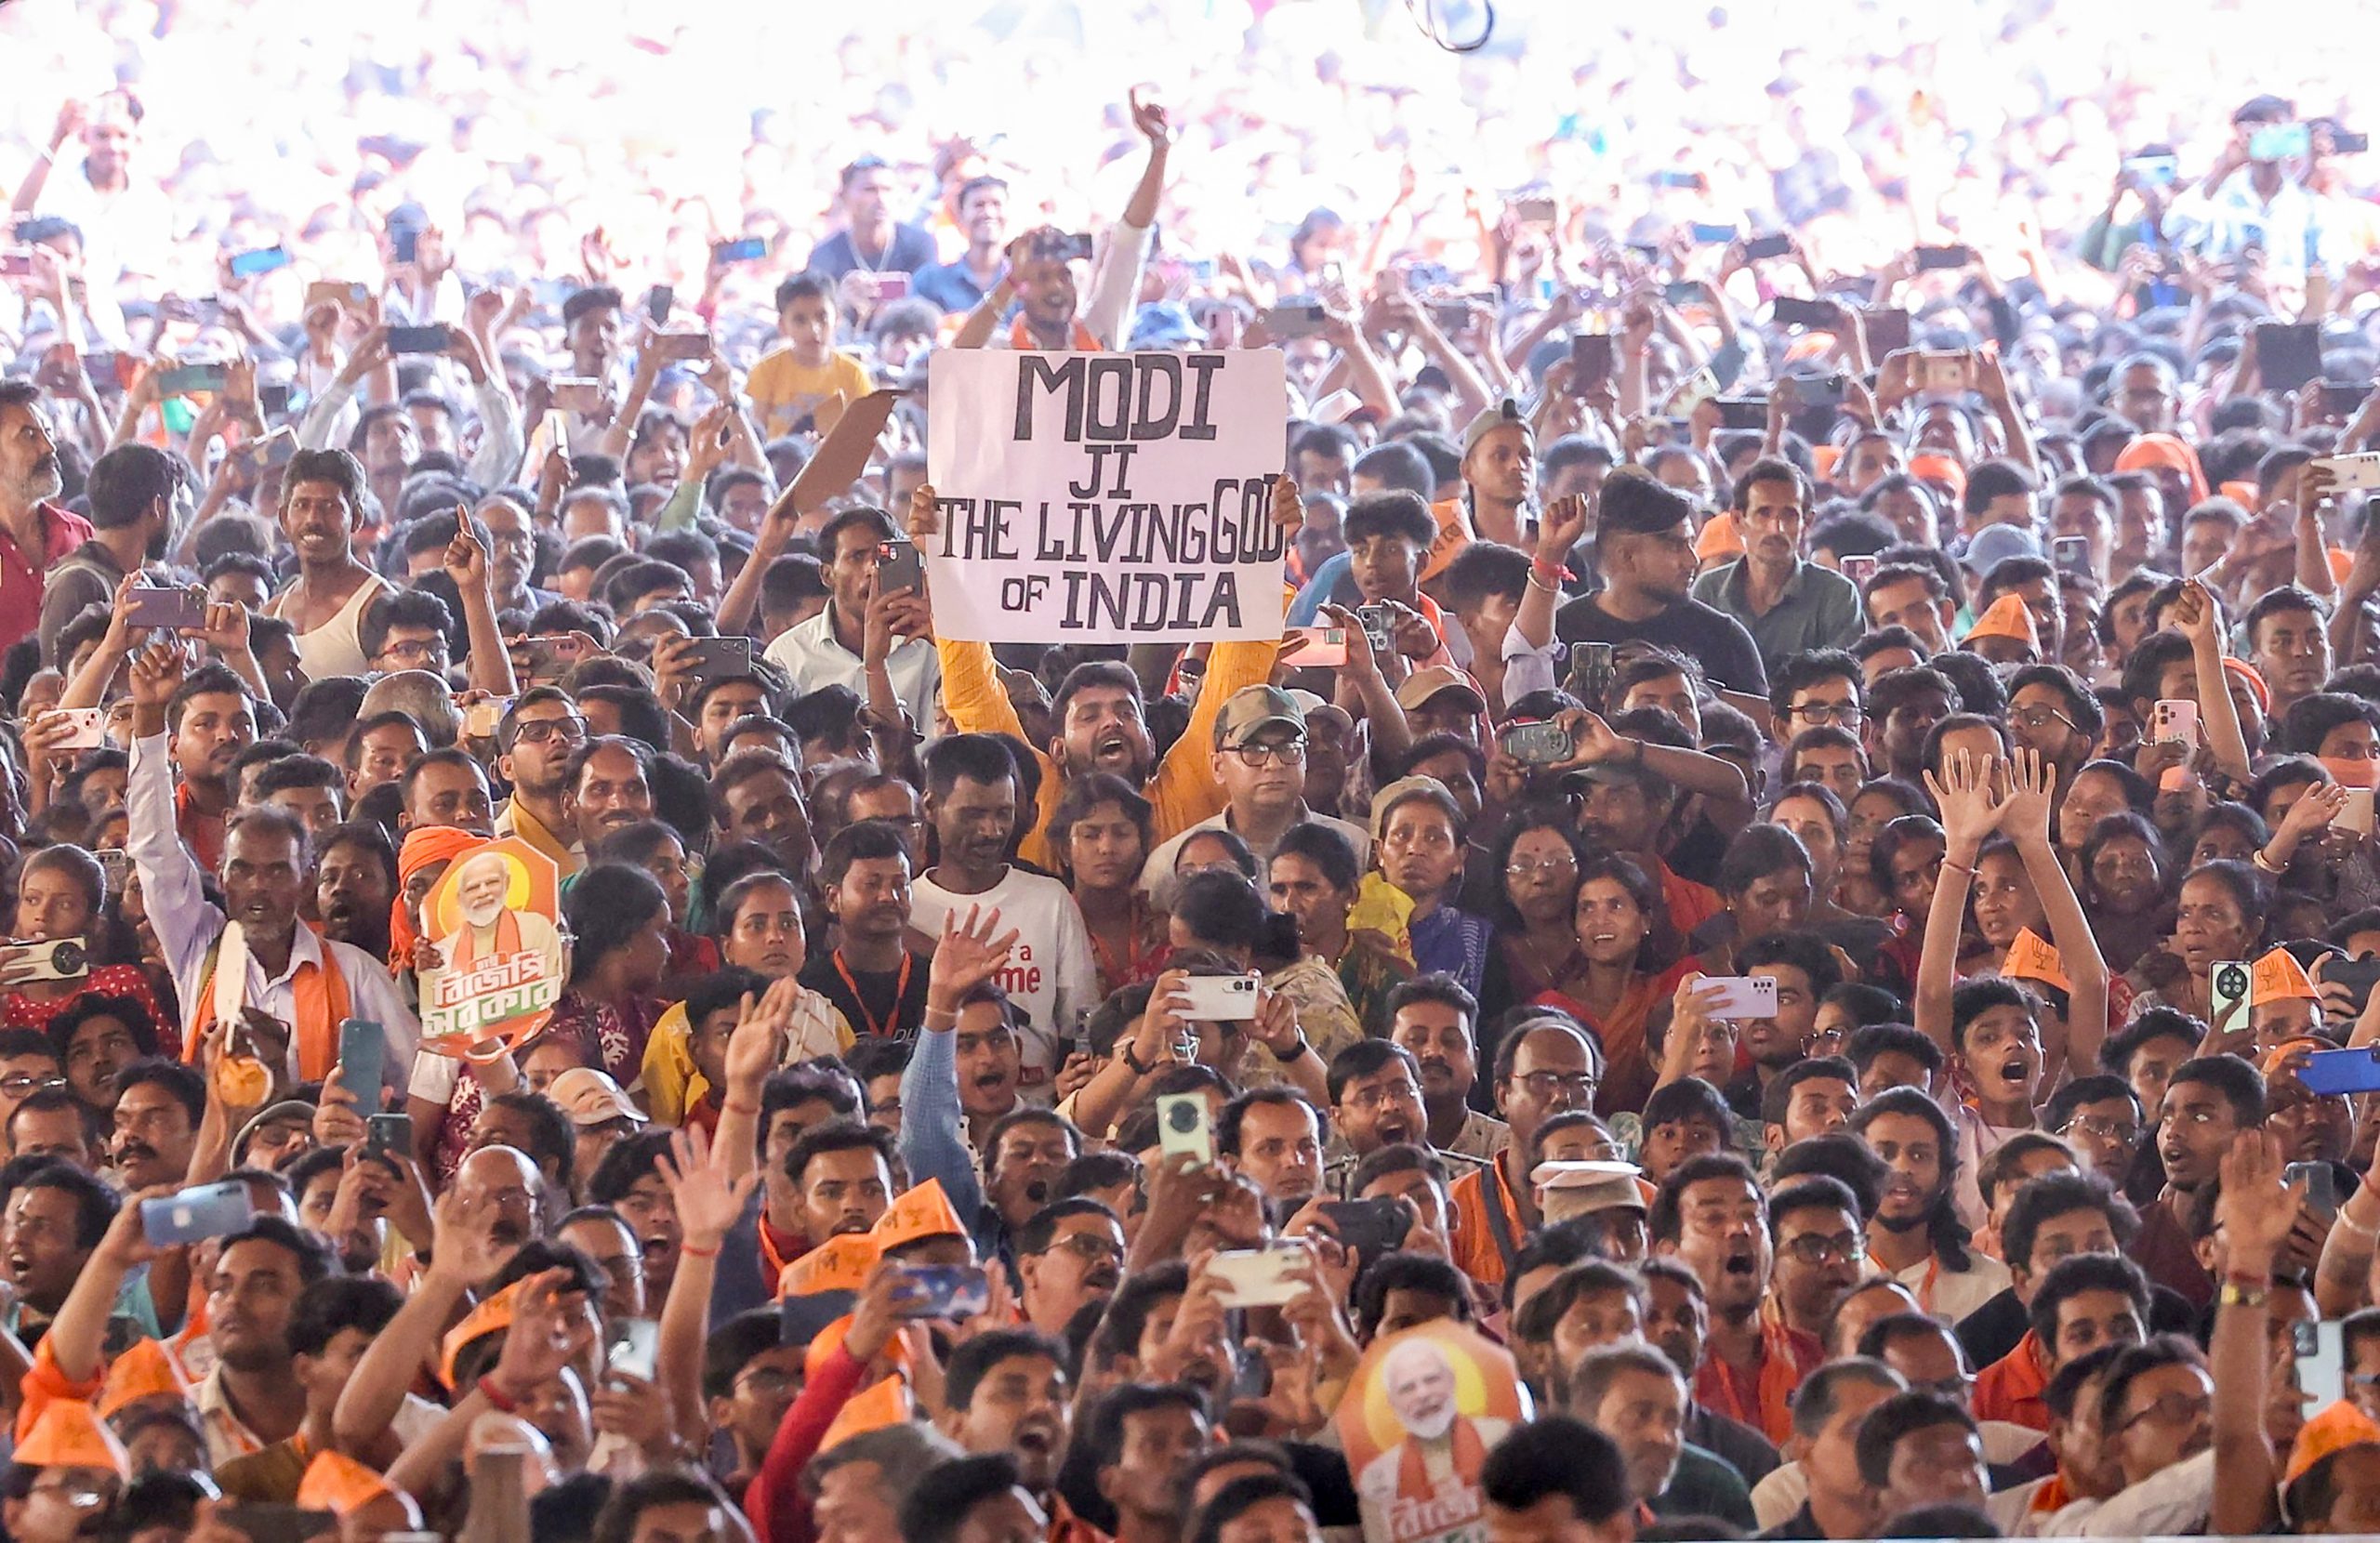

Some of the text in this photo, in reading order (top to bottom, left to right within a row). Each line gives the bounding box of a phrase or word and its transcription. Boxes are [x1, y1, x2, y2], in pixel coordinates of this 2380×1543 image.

[1013, 355, 1224, 442] MODI
[1069, 444, 1137, 499] JI
[935, 474, 1285, 564] THE LIVING GOD
[1001, 571, 1242, 631] OF INDIA
[420, 976, 562, 1038] সরকার
[433, 948, 547, 1006] বিজেপি
[994, 967, 1040, 994] me
